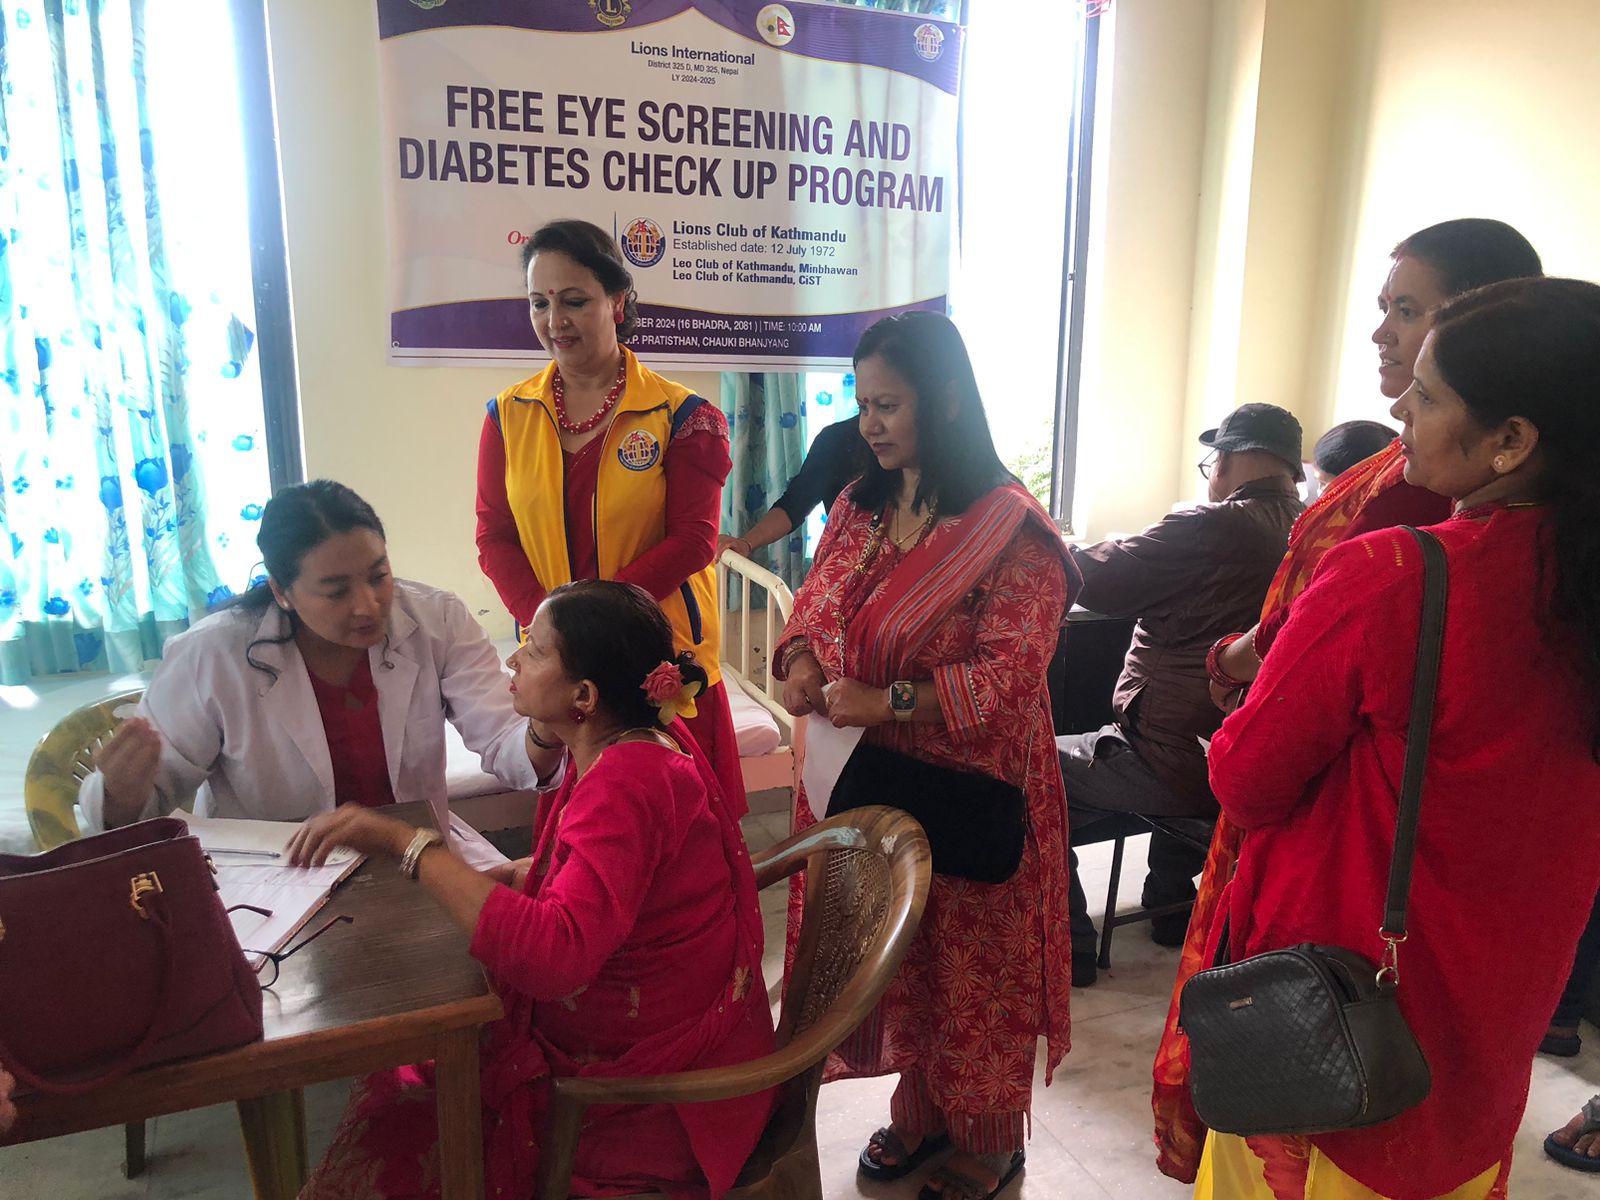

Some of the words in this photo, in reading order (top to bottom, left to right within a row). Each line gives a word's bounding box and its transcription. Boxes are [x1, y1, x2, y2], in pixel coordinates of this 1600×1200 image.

[631, 41, 668, 57] Lions
[672, 45, 755, 65] International
[648, 60, 671, 69] District
[672, 62, 685, 71] 325
[686, 63, 693, 72] D,
[694, 64, 705, 72] MD
[706, 65, 720, 74] 325,
[721, 67, 739, 76] Nepal
[672, 74, 681, 82] LY
[681, 75, 716, 85] 2024-2025
[447, 85, 544, 133] FREE
[557, 94, 626, 139] EYE
[637, 100, 833, 155] SCREENING
[844, 119, 911, 161] AND
[399, 137, 590, 189] DIABETES
[603, 150, 722, 197] CHECK
[733, 159, 777, 199] UP
[788, 163, 944, 213] PROGRAM
[673, 220, 711, 236] Lions
[716, 223, 748, 238] Club
[752, 226, 767, 239] of
[771, 226, 847, 243] Kathmandu
[673, 238, 737, 252] Established
[740, 242, 768, 254] date:
[771, 243, 784, 254] 12
[786, 244, 807, 258] July
[810, 245, 836, 257] 1972
[673, 257, 692, 268] Leo
[695, 258, 719, 269] Club
[722, 260, 733, 270] of
[736, 260, 796, 274] Kathmandu,
[799, 263, 858, 276] Minbhawan
[673, 270, 692, 280] Leo
[695, 271, 719, 281] Club
[722, 271, 733, 282] of
[736, 273, 796, 285] Kathmandu,
[799, 275, 822, 286] CiST
[635, 317, 654, 328] BER
[655, 318, 676, 329] 2024
[677, 318, 691, 331] (16
[692, 319, 732, 330] BHADRA,
[763, 321, 786, 332] TIME:
[788, 322, 807, 333] 10:00
[808, 322, 822, 333] AM
[641, 335, 700, 347] PRATISTHAN,
[702, 336, 737, 347] CHAUKI
[738, 337, 789, 349] BHANJYANG
